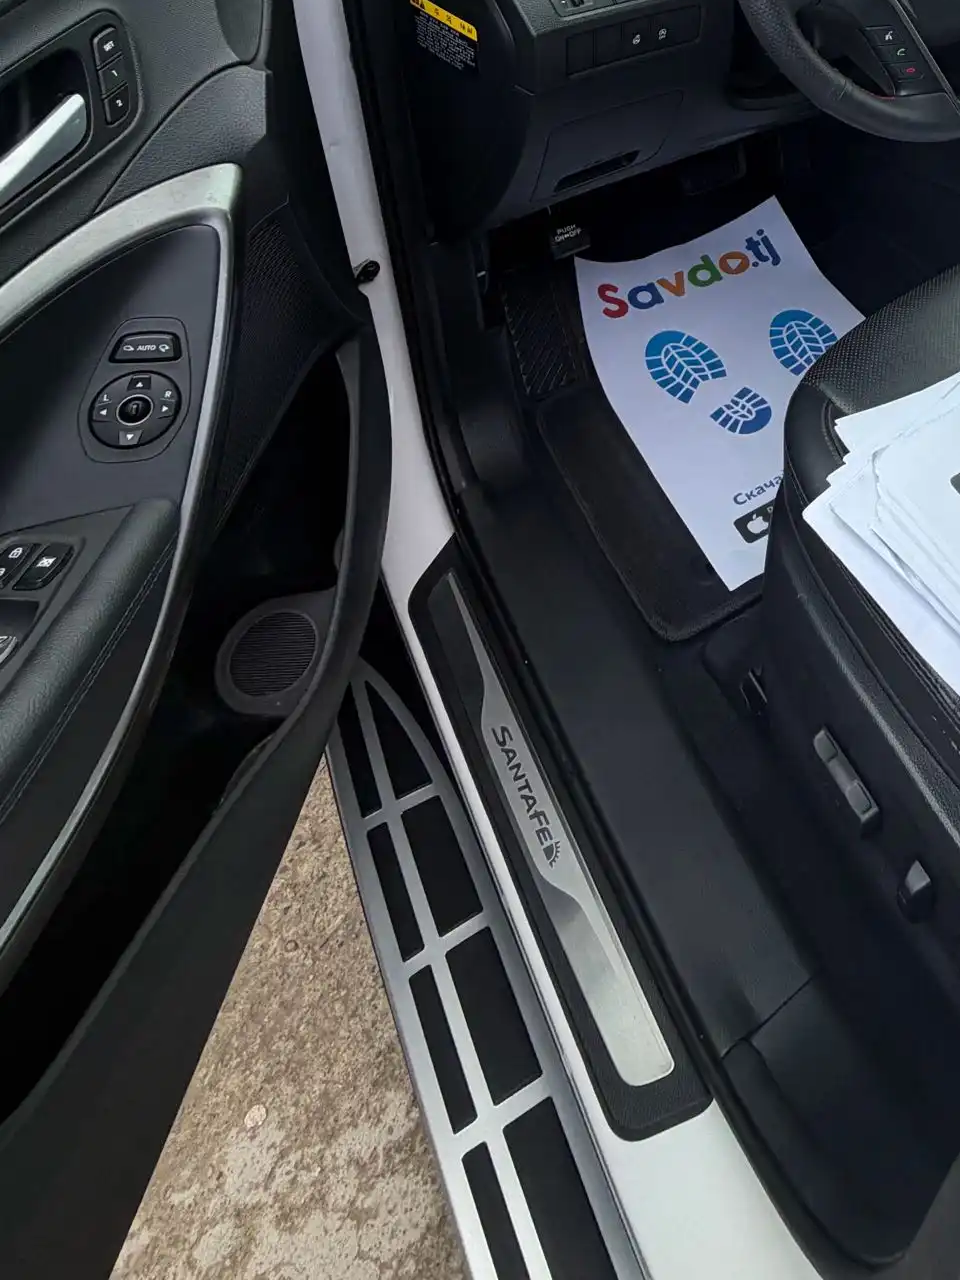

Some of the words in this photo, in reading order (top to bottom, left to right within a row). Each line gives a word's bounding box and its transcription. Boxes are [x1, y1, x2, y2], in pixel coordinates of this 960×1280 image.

[103, 40, 115, 52] SET
[111, 69, 118, 77] 1
[115, 99, 123, 107] 2
[598, 229, 781, 318] Savdo.tj
[164, 390, 172, 398] R
[733, 469, 784, 505] Скача
